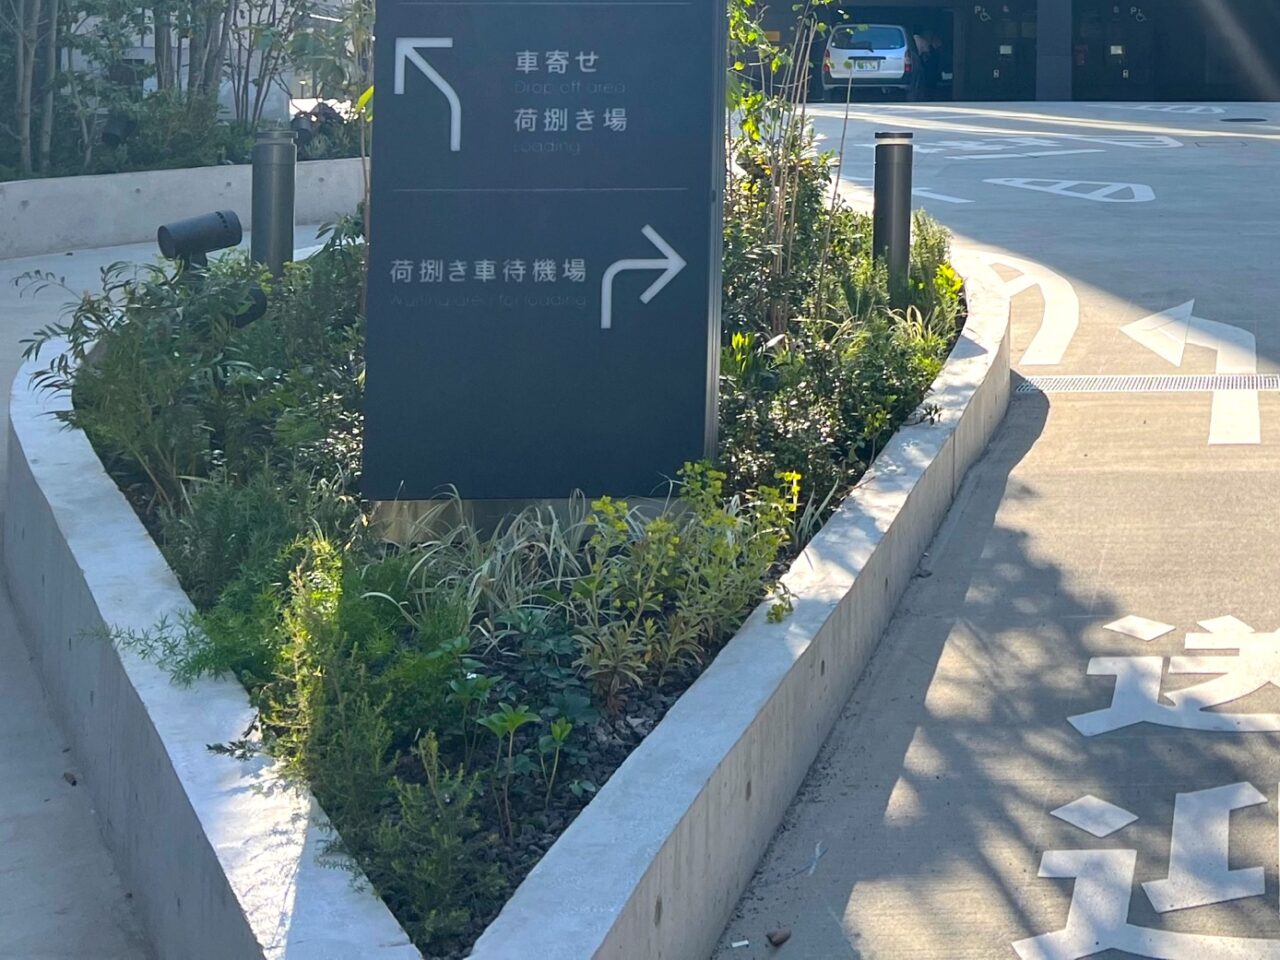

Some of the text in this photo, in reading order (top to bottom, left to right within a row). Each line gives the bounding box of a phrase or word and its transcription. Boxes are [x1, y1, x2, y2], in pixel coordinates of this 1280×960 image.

[514, 49, 600, 75] 車寄せ
[513, 107, 628, 132] 荷捌き場
[389, 258, 588, 284] 荷捌き車待機場
